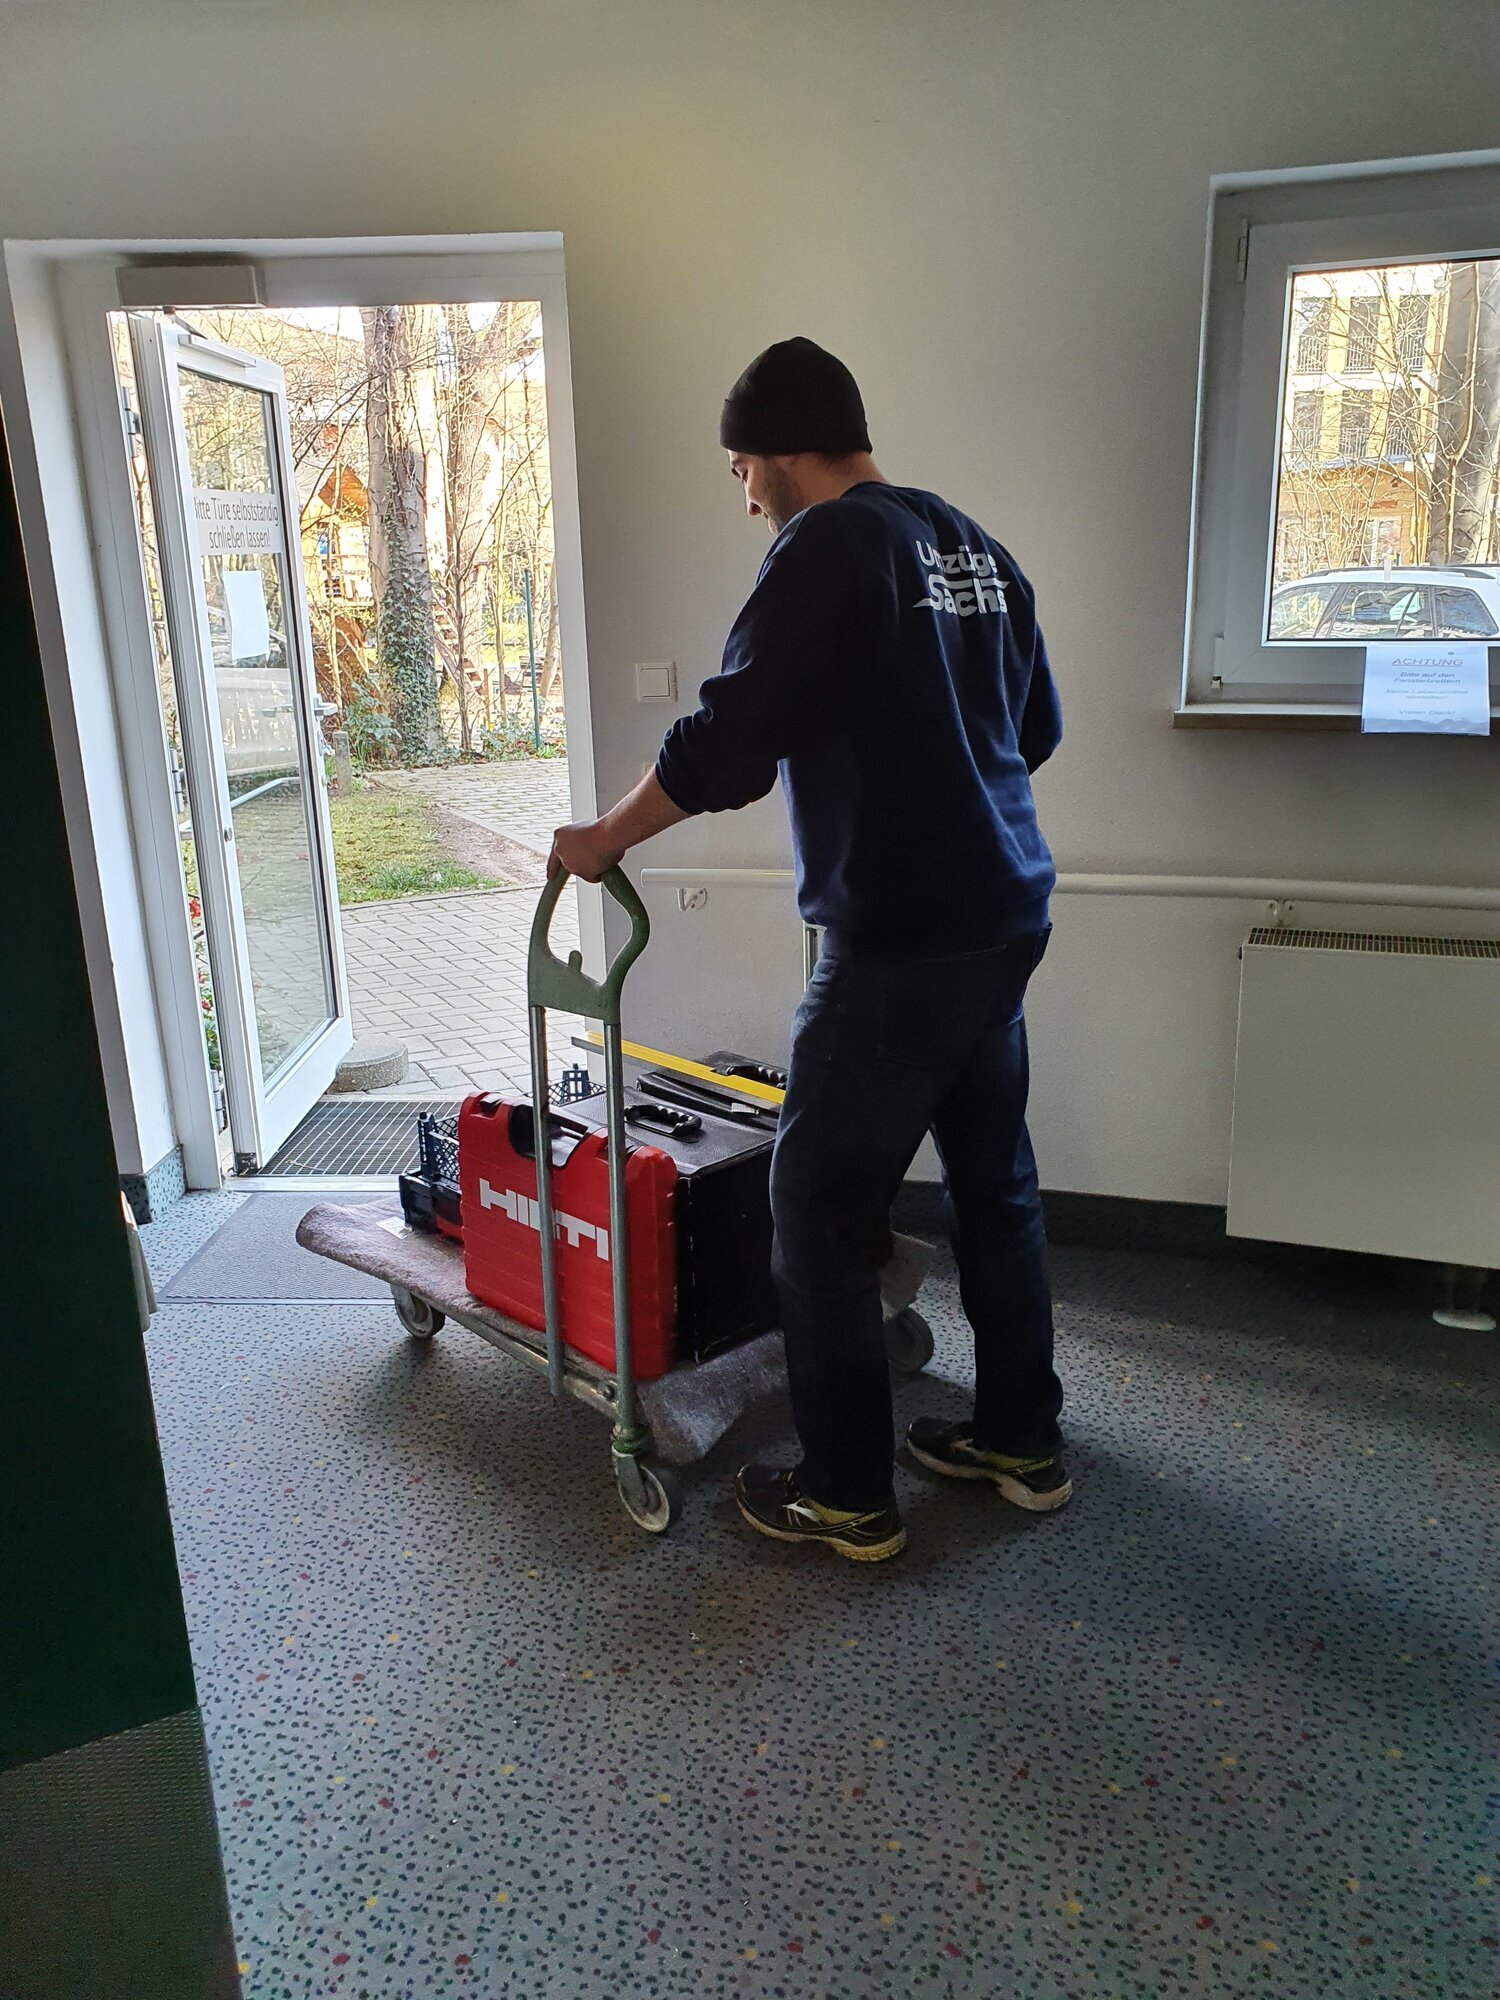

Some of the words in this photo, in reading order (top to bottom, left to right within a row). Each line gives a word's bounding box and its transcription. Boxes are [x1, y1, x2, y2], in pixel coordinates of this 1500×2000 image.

[211, 497, 231, 520] Türe
[232, 498, 279, 526] selbstständig
[209, 525, 245, 548] schließen
[246, 526, 271, 547] lassen!
[914, 574, 1009, 617] Sachs
[1392, 658, 1463, 667] ACHTUNG
[480, 1178, 609, 1261] HILTI
